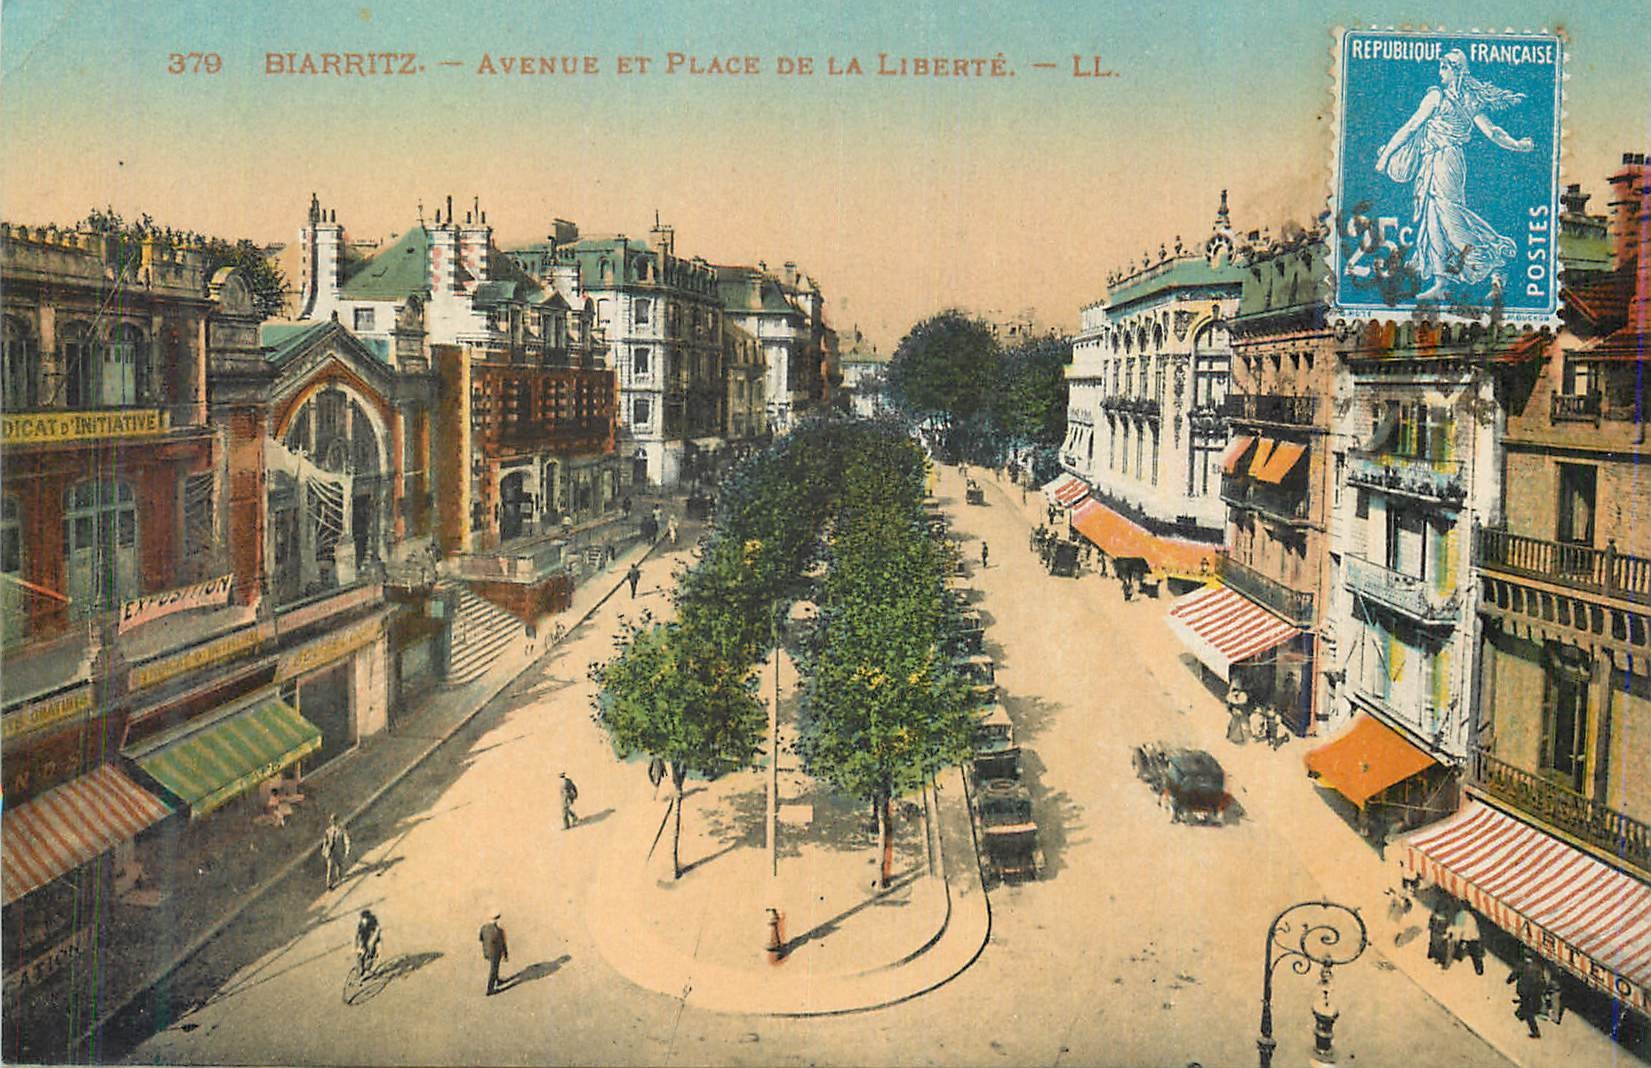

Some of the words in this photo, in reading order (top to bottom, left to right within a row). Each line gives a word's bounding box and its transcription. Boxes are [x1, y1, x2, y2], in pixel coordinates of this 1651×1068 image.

[1352, 39, 1442, 64] REPUBLIQUE
[1470, 43, 1553, 66] FRANÇAISE
[1527, 204, 1549, 297] POSTES
[123, 575, 231, 621] EXPOSITION
